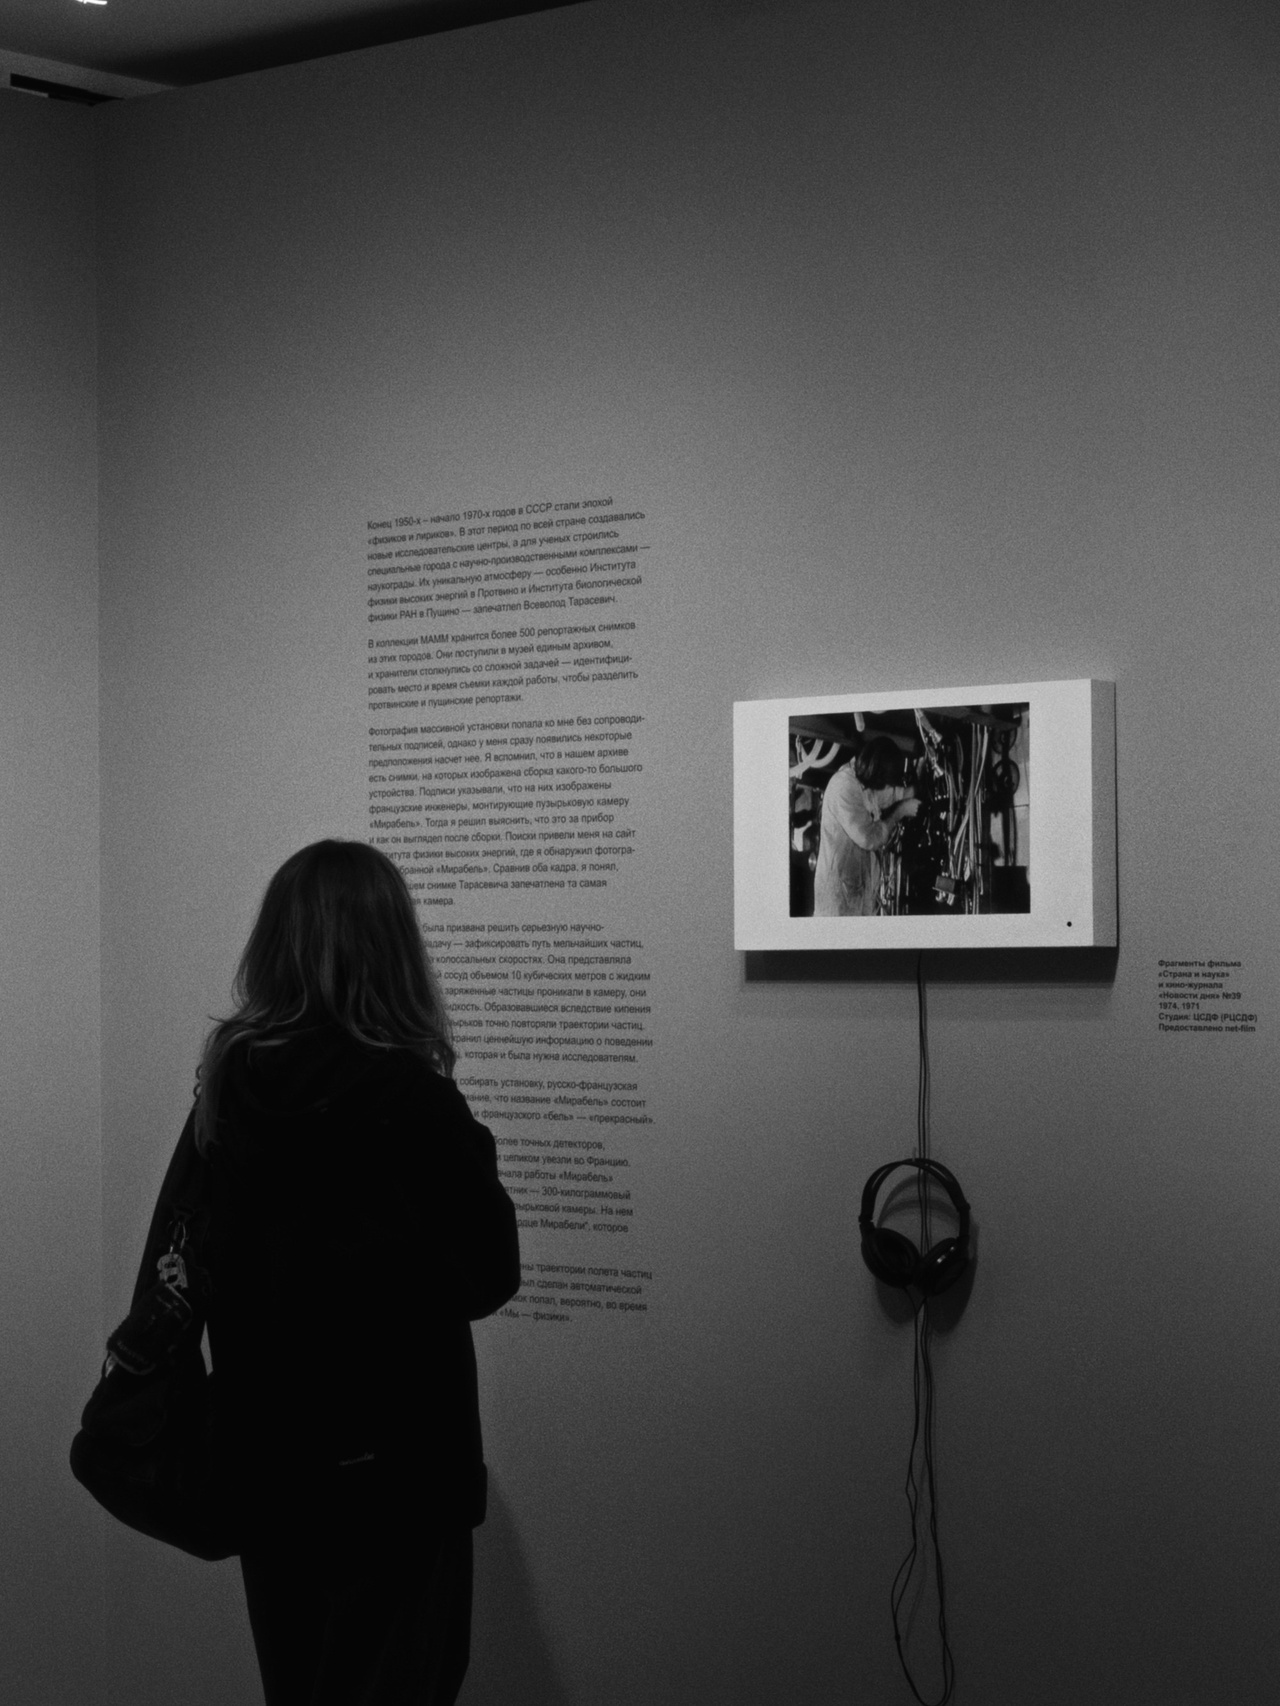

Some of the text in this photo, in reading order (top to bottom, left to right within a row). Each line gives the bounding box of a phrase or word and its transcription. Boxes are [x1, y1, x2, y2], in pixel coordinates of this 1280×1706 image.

[467, 527, 485, 536] этот
[487, 524, 519, 534] период
[520, 522, 532, 530] по
[532, 519, 554, 529] всей
[555, 517, 586, 528] стране
[588, 512, 646, 524] создавались
[367, 598, 398, 608] физики
[398, 594, 433, 604] высоких
[435, 590, 468, 601] энергий
[477, 588, 519, 598] Протвино
[528, 583, 574, 593] Института
[575, 576, 642, 589] биологической
[369, 743, 402, 752] тельных
[404, 740, 446, 750] подписей,
[447, 739, 477, 748] однако
[485, 738, 508, 746] меня
[509, 737, 534, 746] сразу
[535, 734, 582, 744] появились
[584, 732, 632, 741] некоторые
[419, 786, 456, 797] Подписи
[458, 786, 506, 796] указывали,
[507, 785, 523, 793] что
[537, 784, 554, 792] них
[555, 781, 612, 791] изображены
[423, 924, 604, 933] была призвана решить серьезную научно-
[1158, 960, 1241, 968] Фрагменты фильма
[444, 972, 469, 981] сосуд
[469, 970, 509, 980] объемом
[523, 970, 572, 981] кубических
[574, 972, 607, 981] метров
[1158, 970, 1192, 978] «Страна
[1159, 991, 1198, 999] «Новости
[1159, 1002, 1179, 1010] 1974,
[1158, 1013, 1257, 1022] Студия: ЦСДФ (РЦСДФ)
[1158, 1023, 1223, 1032] Предоставлено
[460, 1076, 638, 1092] собирать установку, русско-французская
[504, 1154, 540, 1163] целиком
[542, 1156, 572, 1164] увезли
[524, 1169, 556, 1180] работы
[536, 1264, 653, 1280] траектории полета частиц
